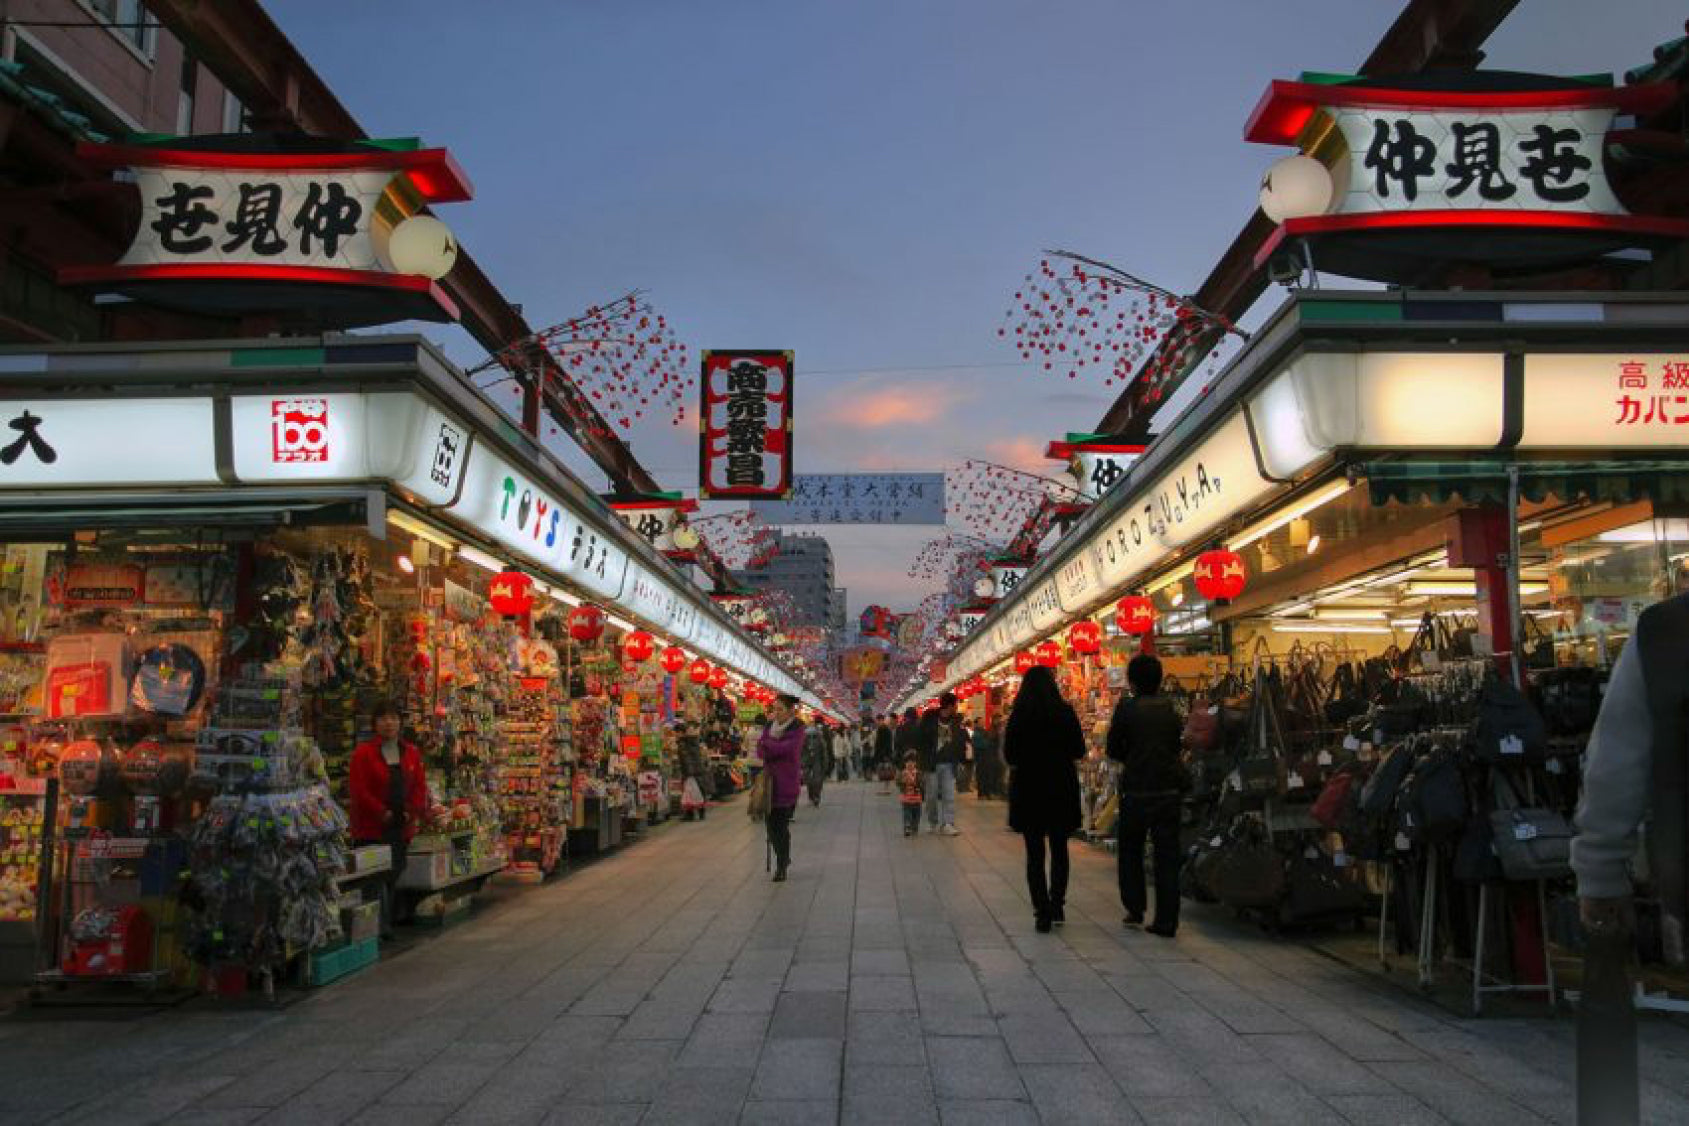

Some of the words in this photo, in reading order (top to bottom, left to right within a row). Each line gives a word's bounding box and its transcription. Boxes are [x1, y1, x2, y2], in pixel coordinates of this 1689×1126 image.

[1364, 118, 1592, 202] 仲見世
[1618, 360, 1689, 390] 高級
[500, 476, 561, 549] TOYS
